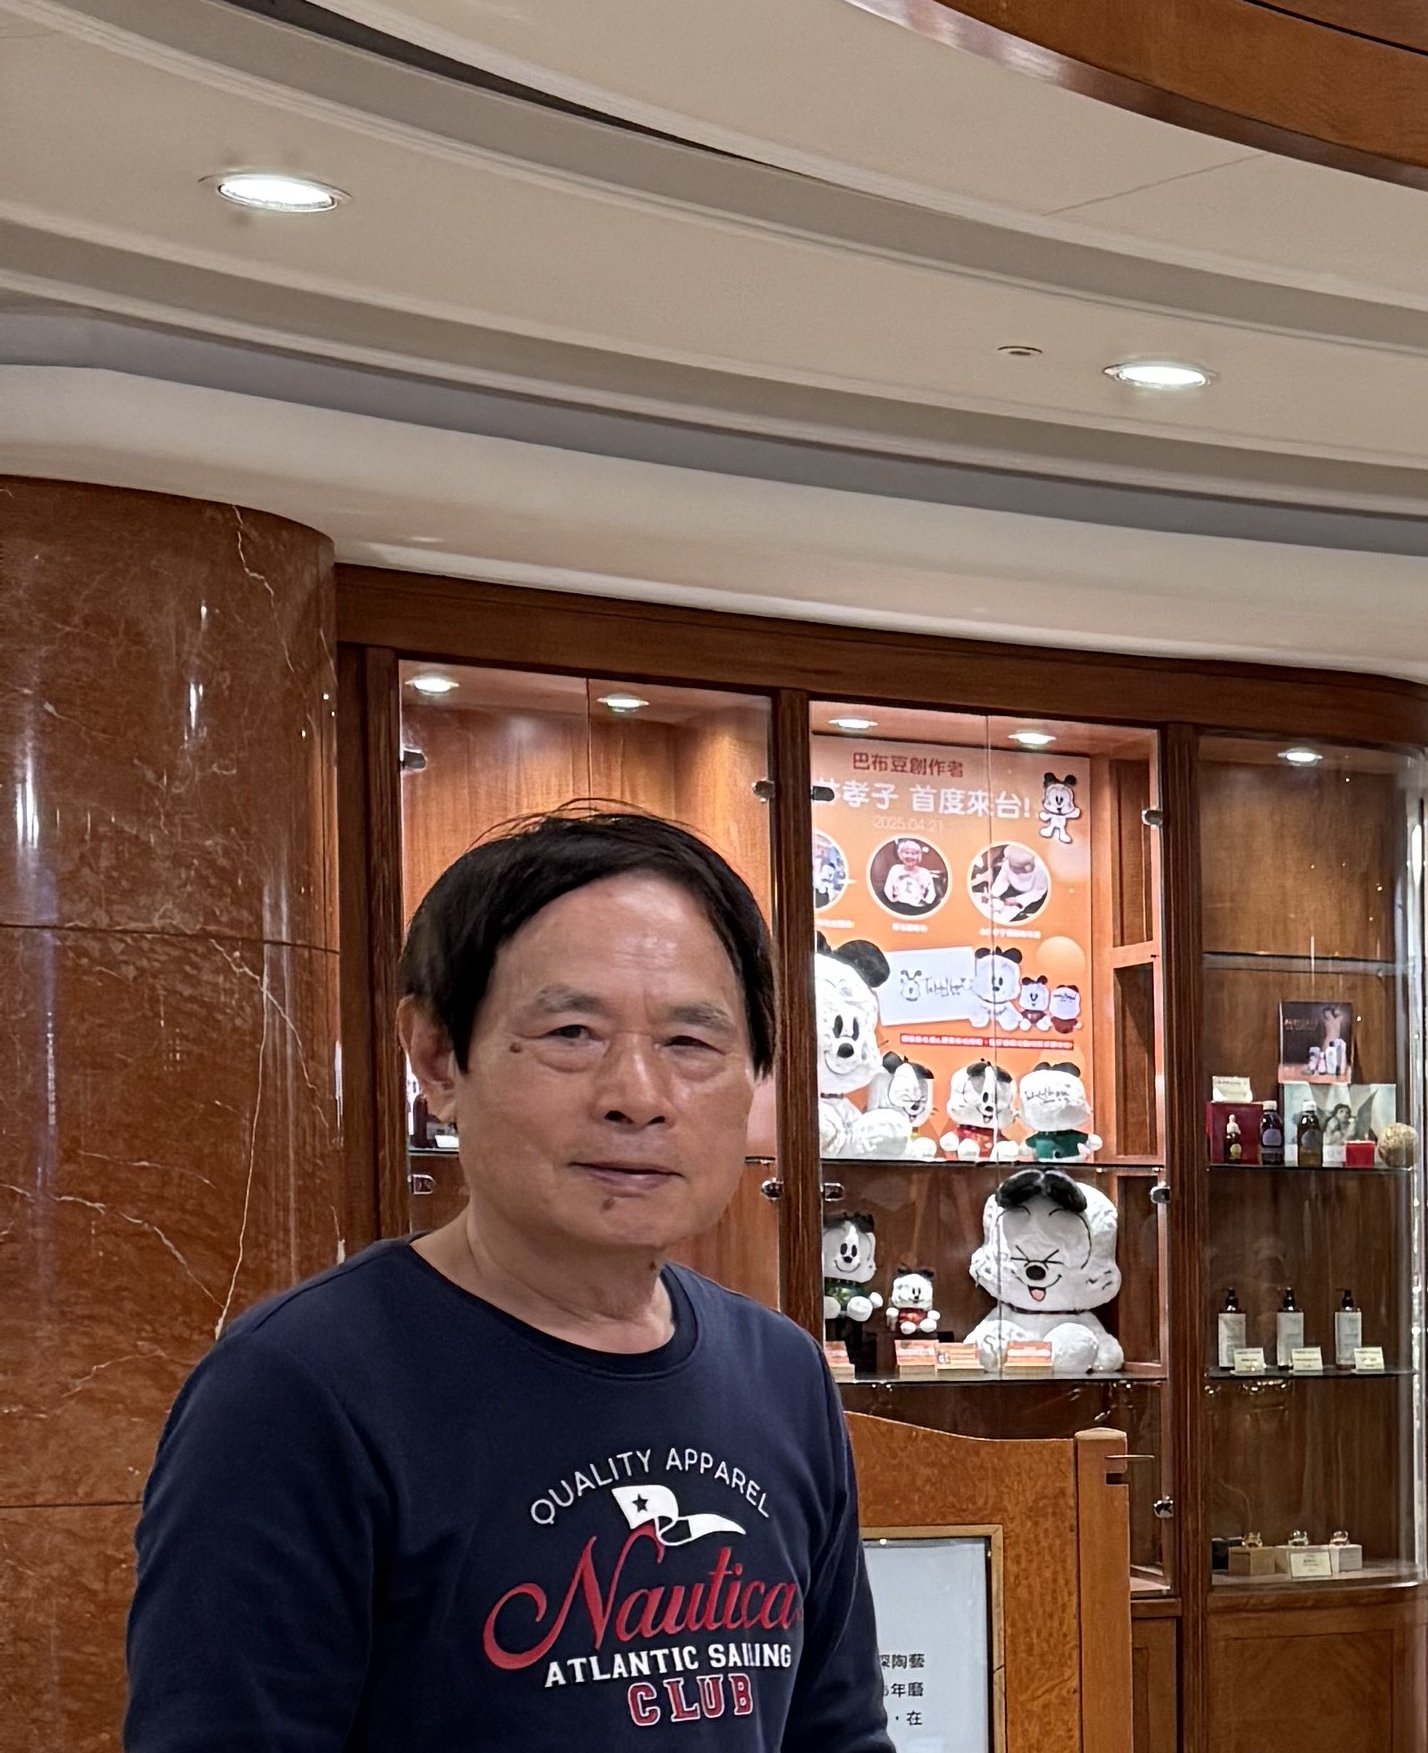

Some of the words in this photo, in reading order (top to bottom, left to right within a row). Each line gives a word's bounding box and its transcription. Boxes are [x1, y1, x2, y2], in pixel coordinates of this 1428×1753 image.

[853, 752, 964, 777] 巴布豆創作者
[530, 1449, 652, 1525] QUALITY
[665, 1447, 770, 1518] APPAREL
[483, 1523, 799, 1670] Nautica
[544, 1645, 699, 1688] ATLANTIC
[708, 1643, 792, 1668] SAILING
[627, 1673, 754, 1727] CLUB
